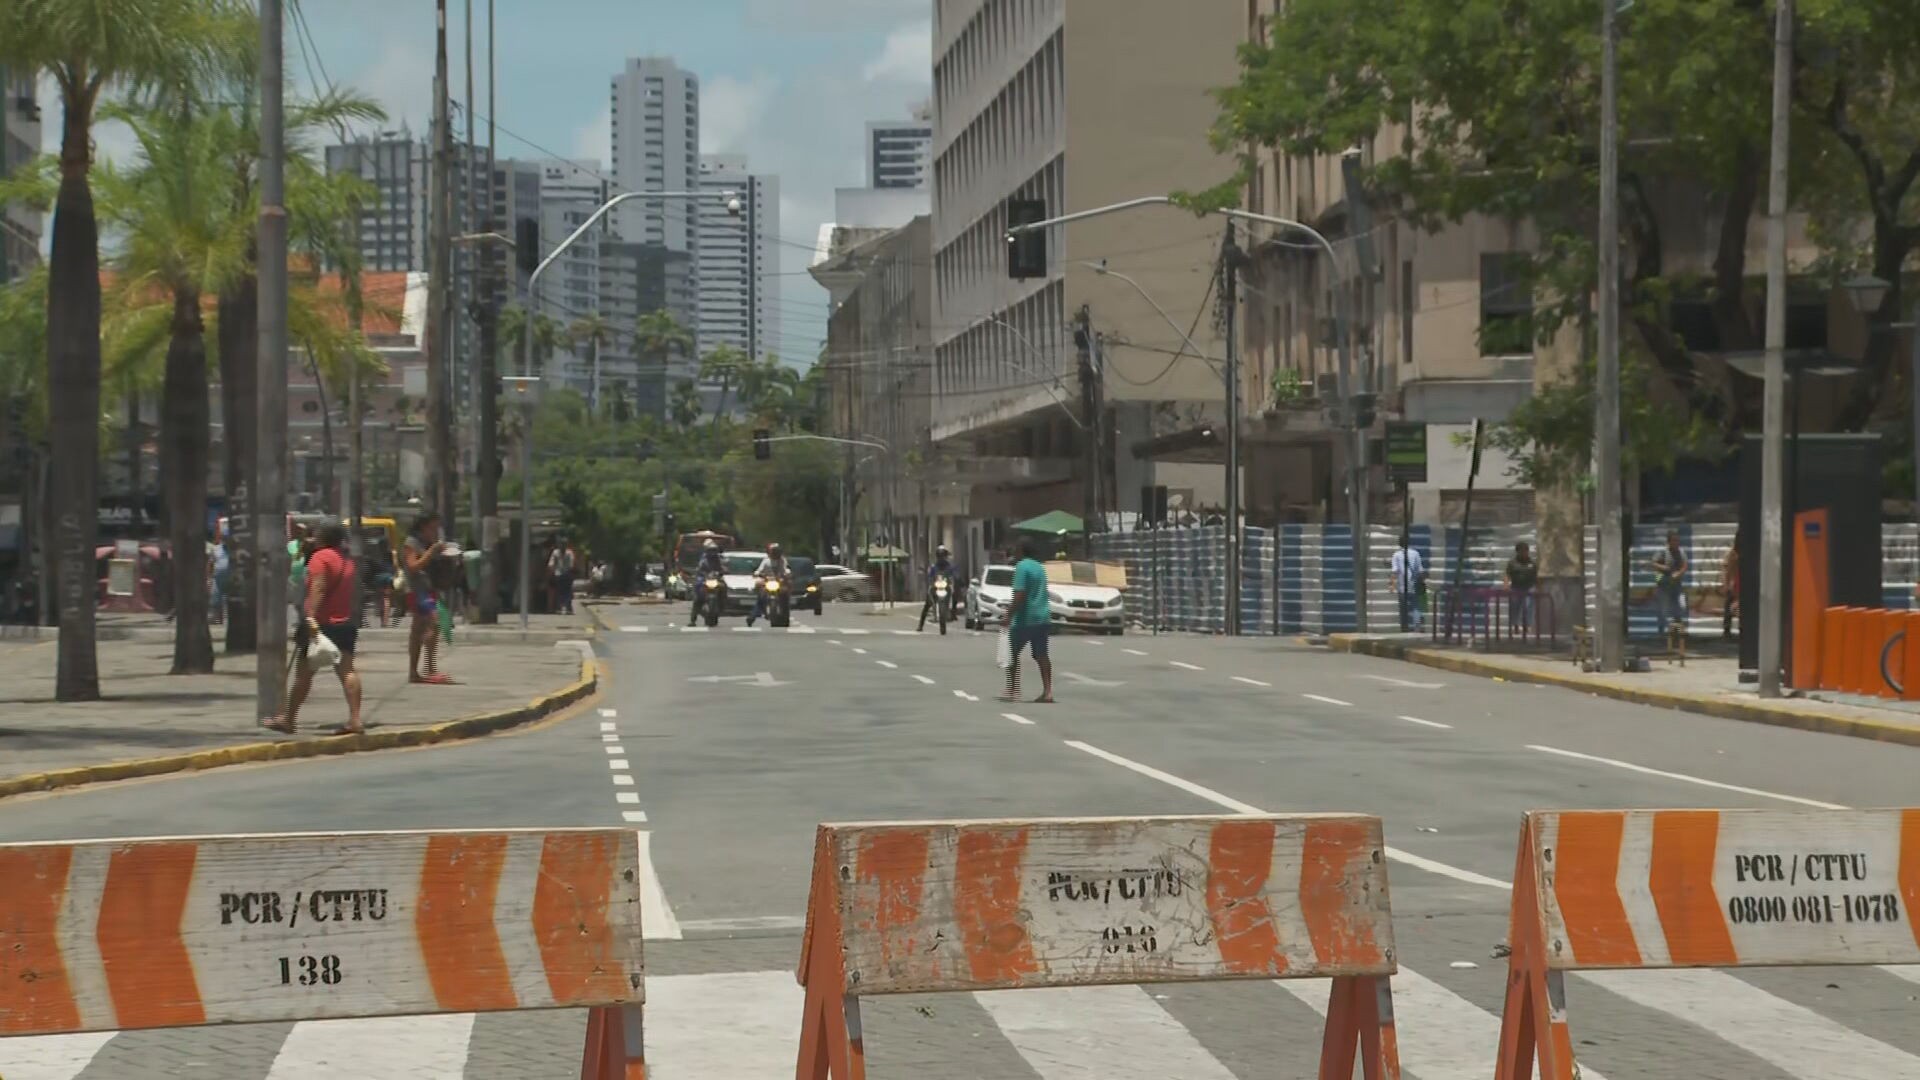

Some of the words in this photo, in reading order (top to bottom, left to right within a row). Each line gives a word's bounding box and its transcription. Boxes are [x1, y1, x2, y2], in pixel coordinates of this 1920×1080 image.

[1728, 895, 1786, 924] 0800
[1792, 894, 1899, 924] 081-1078
[279, 954, 342, 985] 138
